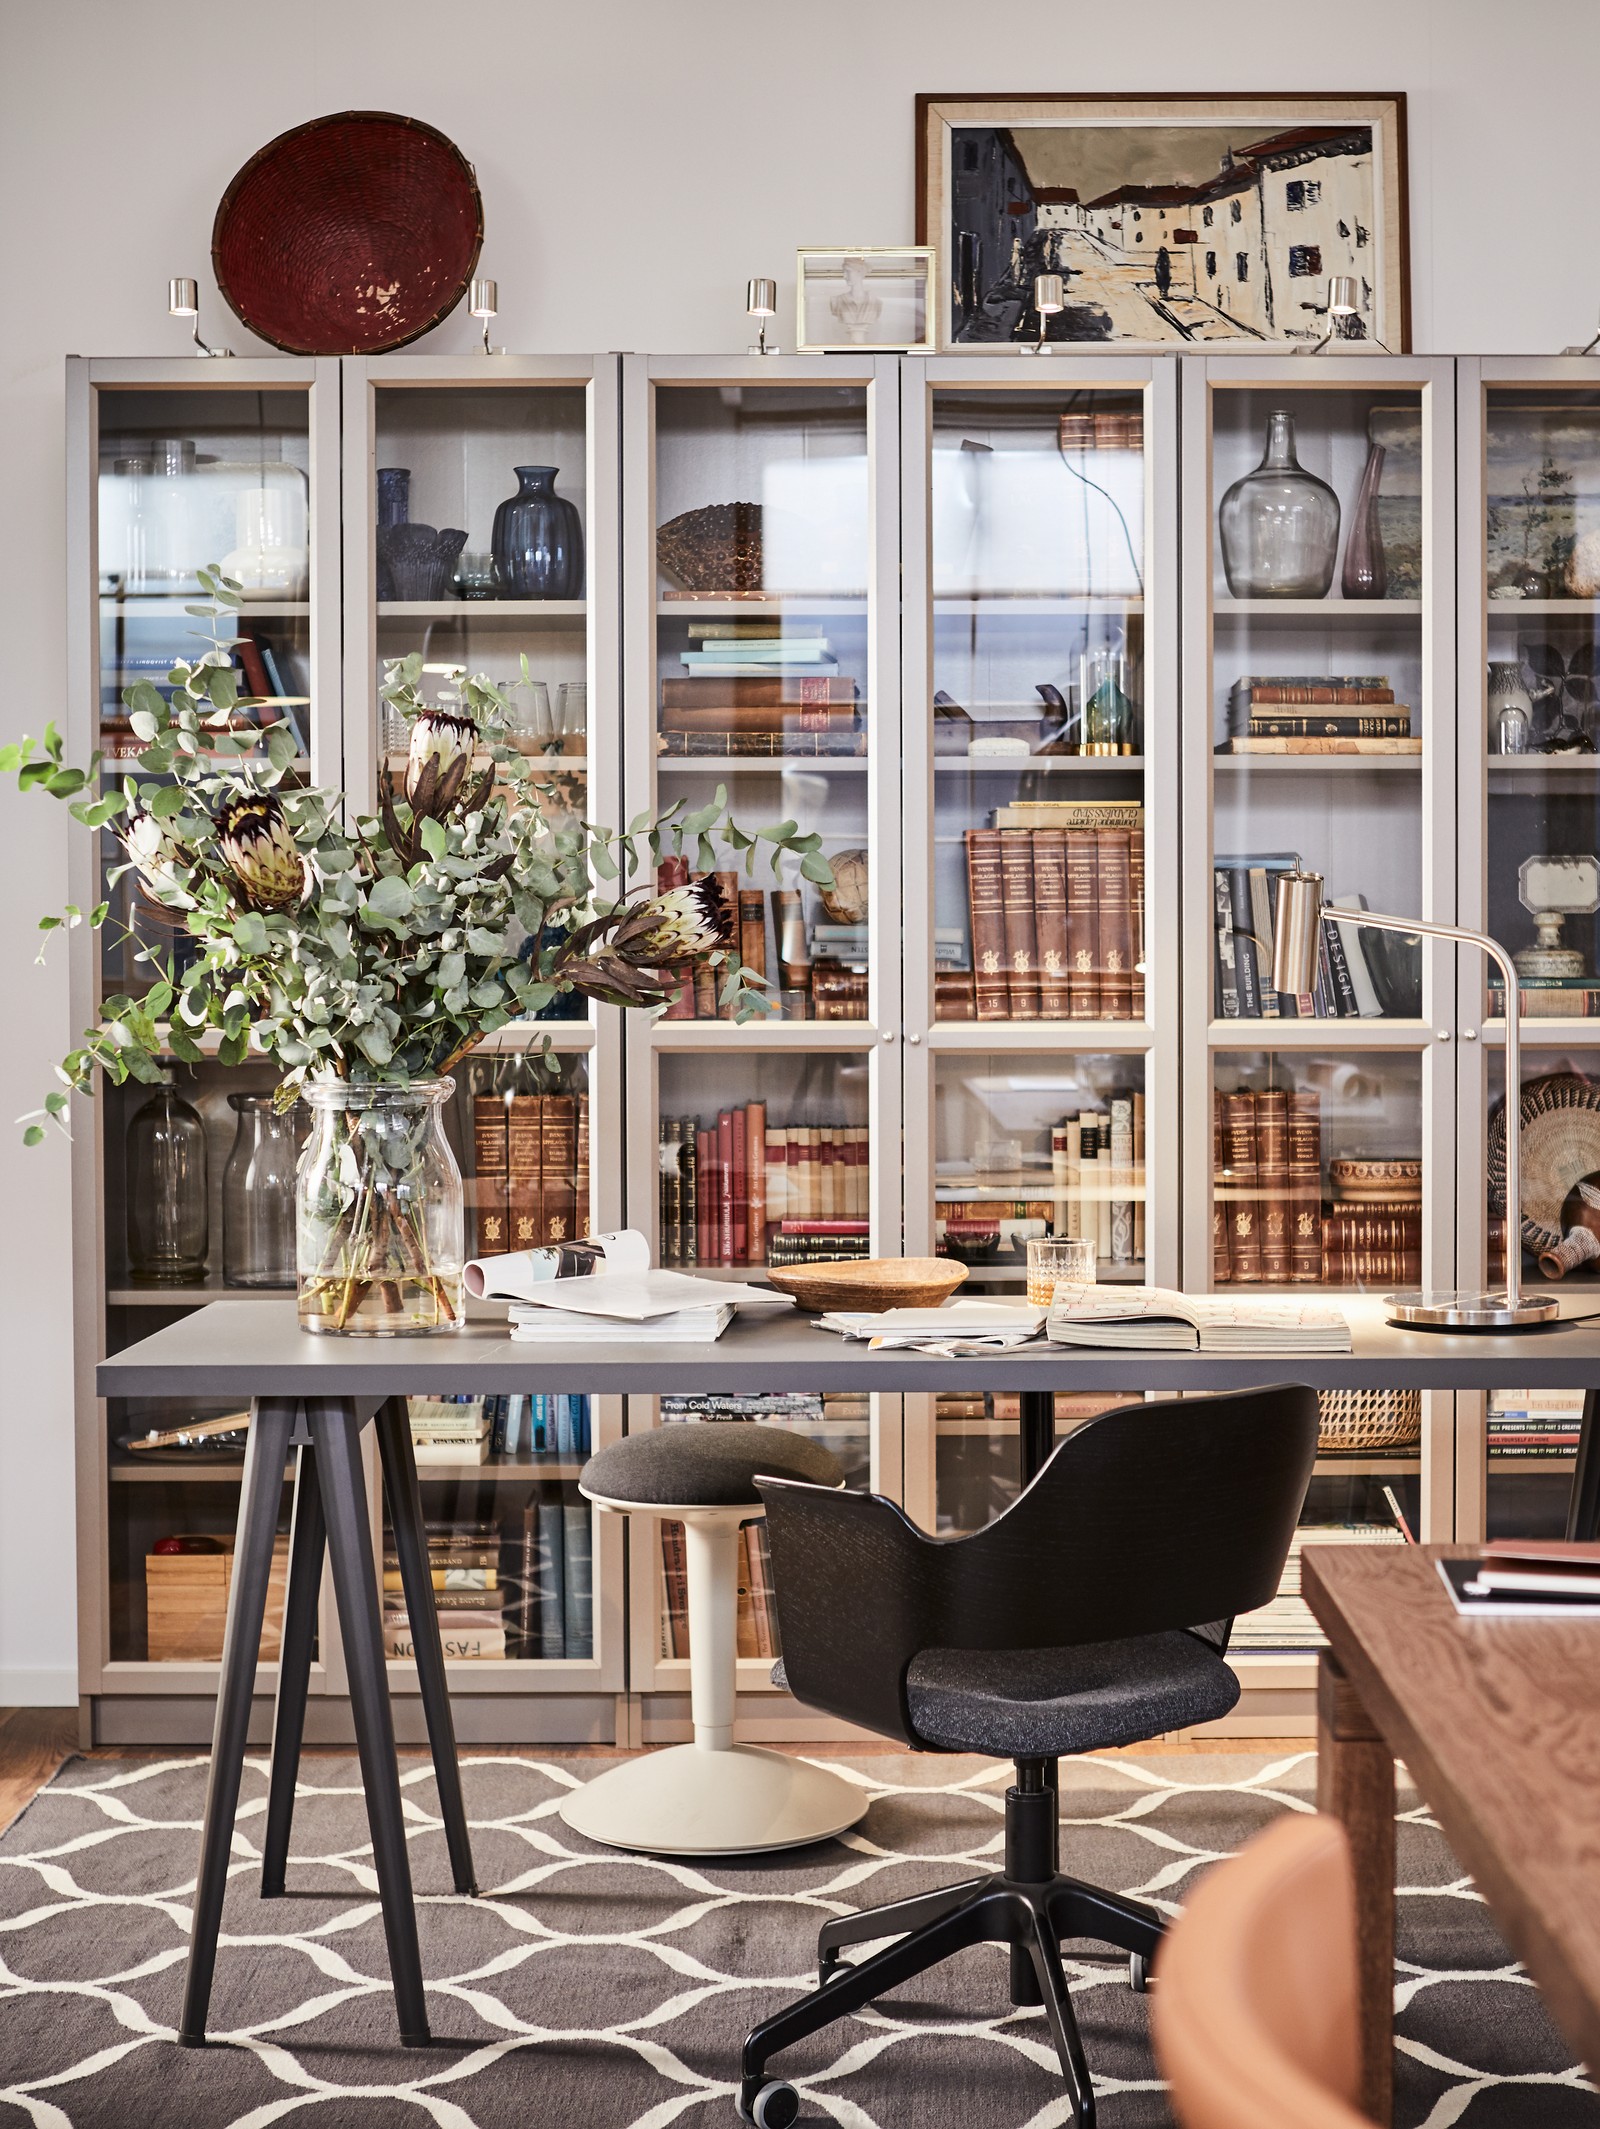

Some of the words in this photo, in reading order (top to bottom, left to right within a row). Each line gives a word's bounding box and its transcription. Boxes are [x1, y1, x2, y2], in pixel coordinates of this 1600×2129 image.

[1327, 930, 1352, 996] DESIGN
[1243, 953, 1252, 991] BUILDING
[988, 1000, 998, 1008] 15
[1020, 999, 1027, 1008] 9
[1049, 999, 1059, 1007] 10
[1082, 998, 1088, 1007] 9
[1112, 998, 1119, 1007] 9
[1242, 1261, 1249, 1270] 9
[1273, 1261, 1280, 1270] 9
[1303, 1261, 1310, 1270] 9
[665, 1401, 687, 1410] From
[688, 1400, 710, 1410] Cold
[711, 1400, 742, 1410] Waters
[670, 1523, 681, 1565] Hundra
[393, 1641, 481, 1656] FASON
